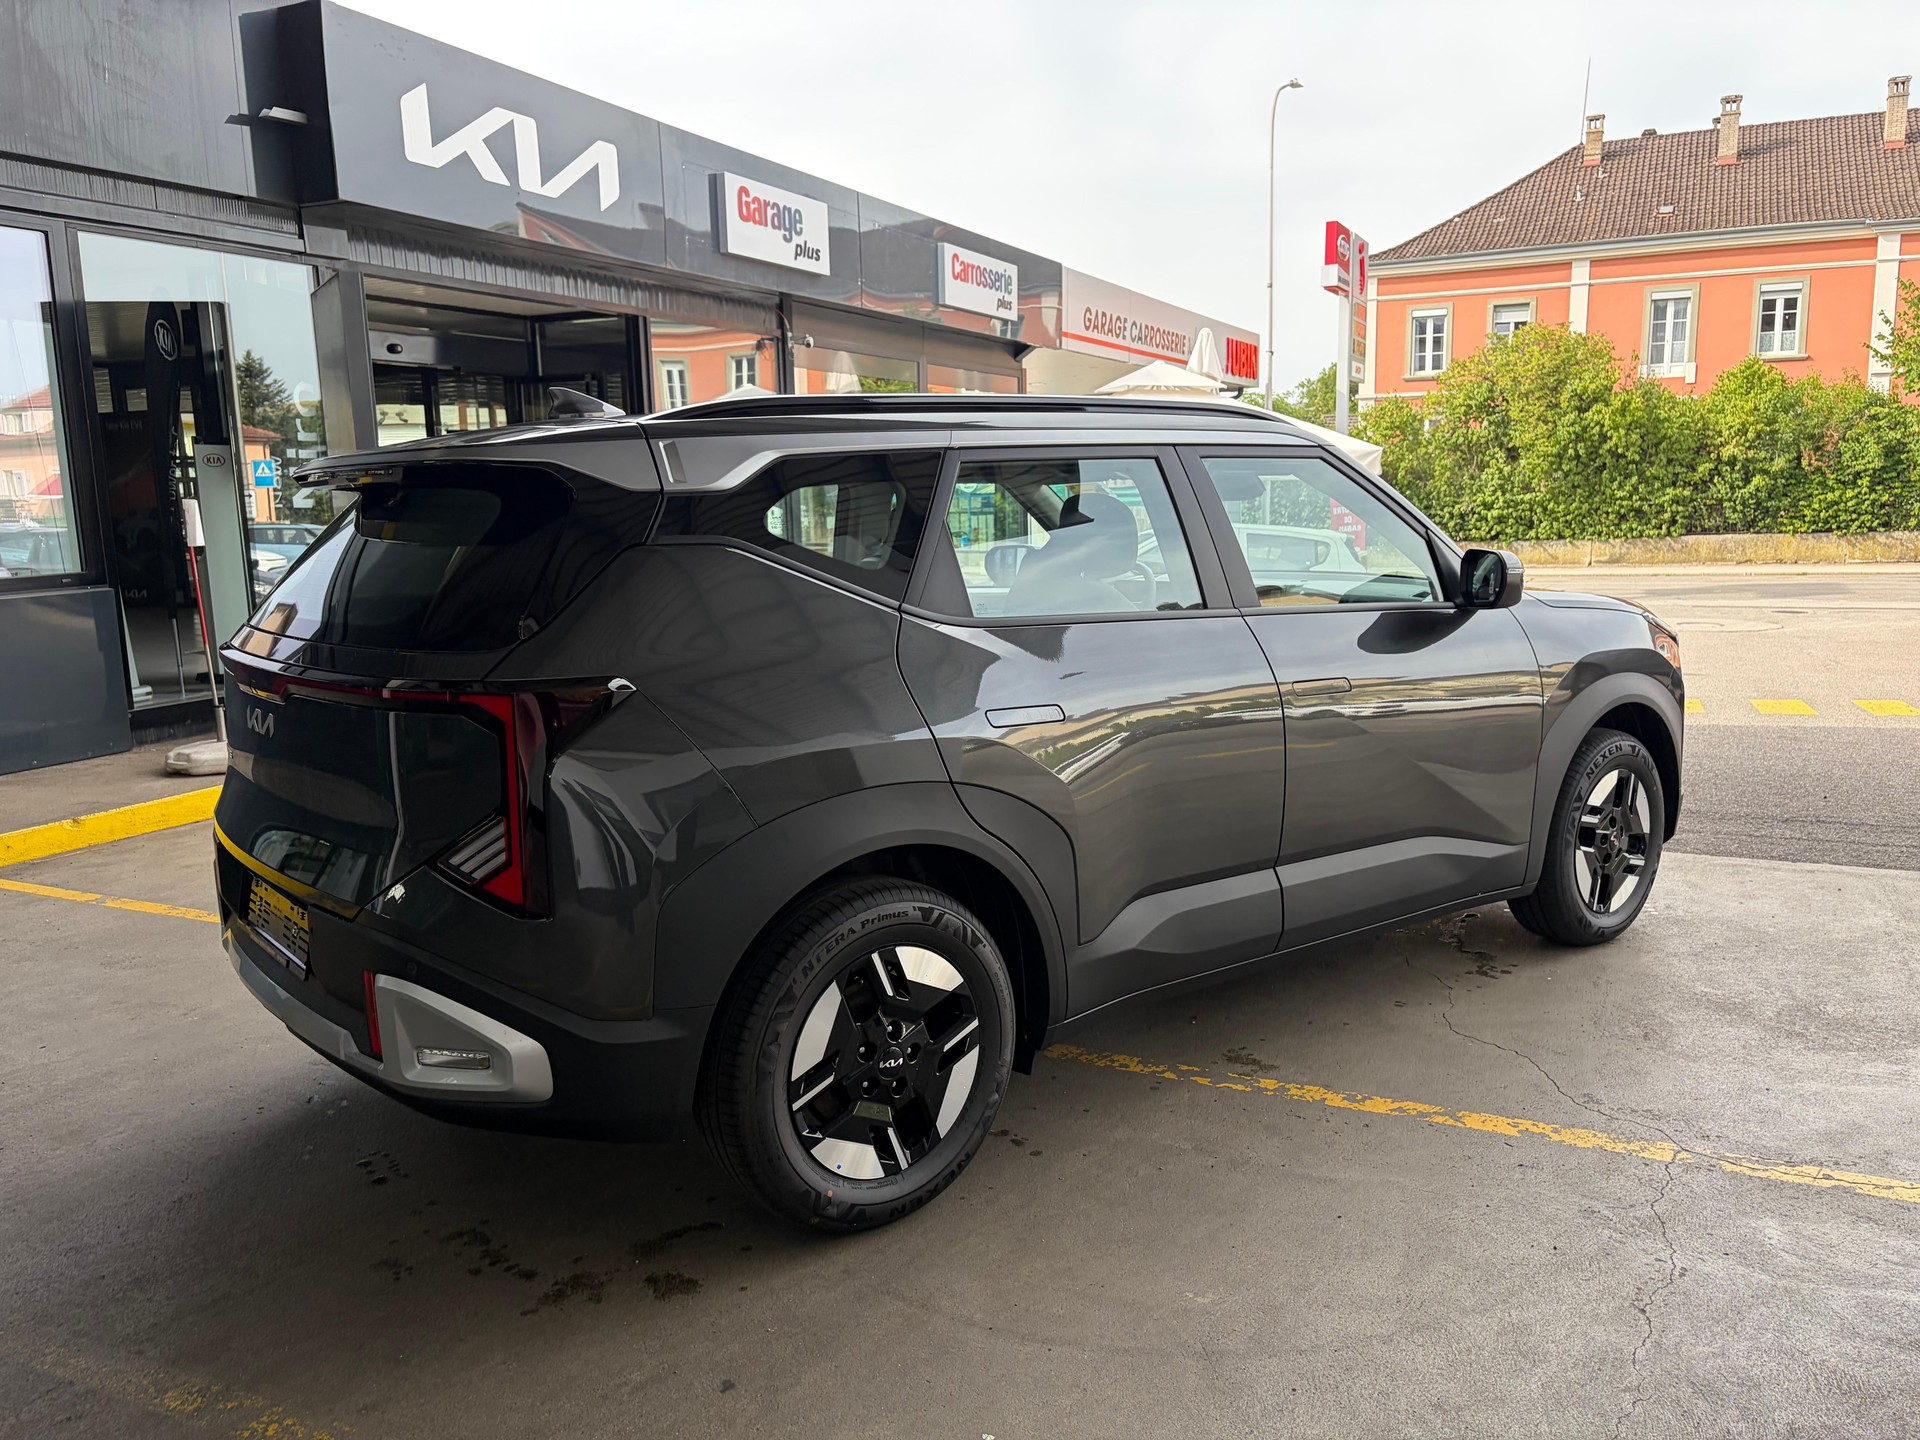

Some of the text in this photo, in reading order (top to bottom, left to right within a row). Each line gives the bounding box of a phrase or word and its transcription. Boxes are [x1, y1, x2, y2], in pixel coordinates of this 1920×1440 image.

[400, 82, 621, 212] KIA
[737, 185, 803, 243] Garage
[794, 240, 821, 262] plus
[951, 252, 1012, 295] Carrosserie
[996, 295, 1013, 312] plus
[157, 323, 176, 357] KIA
[1083, 306, 1128, 341] GARAGE
[1130, 320, 1187, 355] CARROSSERIE
[1226, 337, 1259, 381] JUBIN
[206, 455, 222, 465] KIA
[246, 705, 274, 738] KIA
[1585, 743, 1623, 780] NEXEN
[860, 910, 910, 930] Primus
[879, 1057, 904, 1069] KIA
